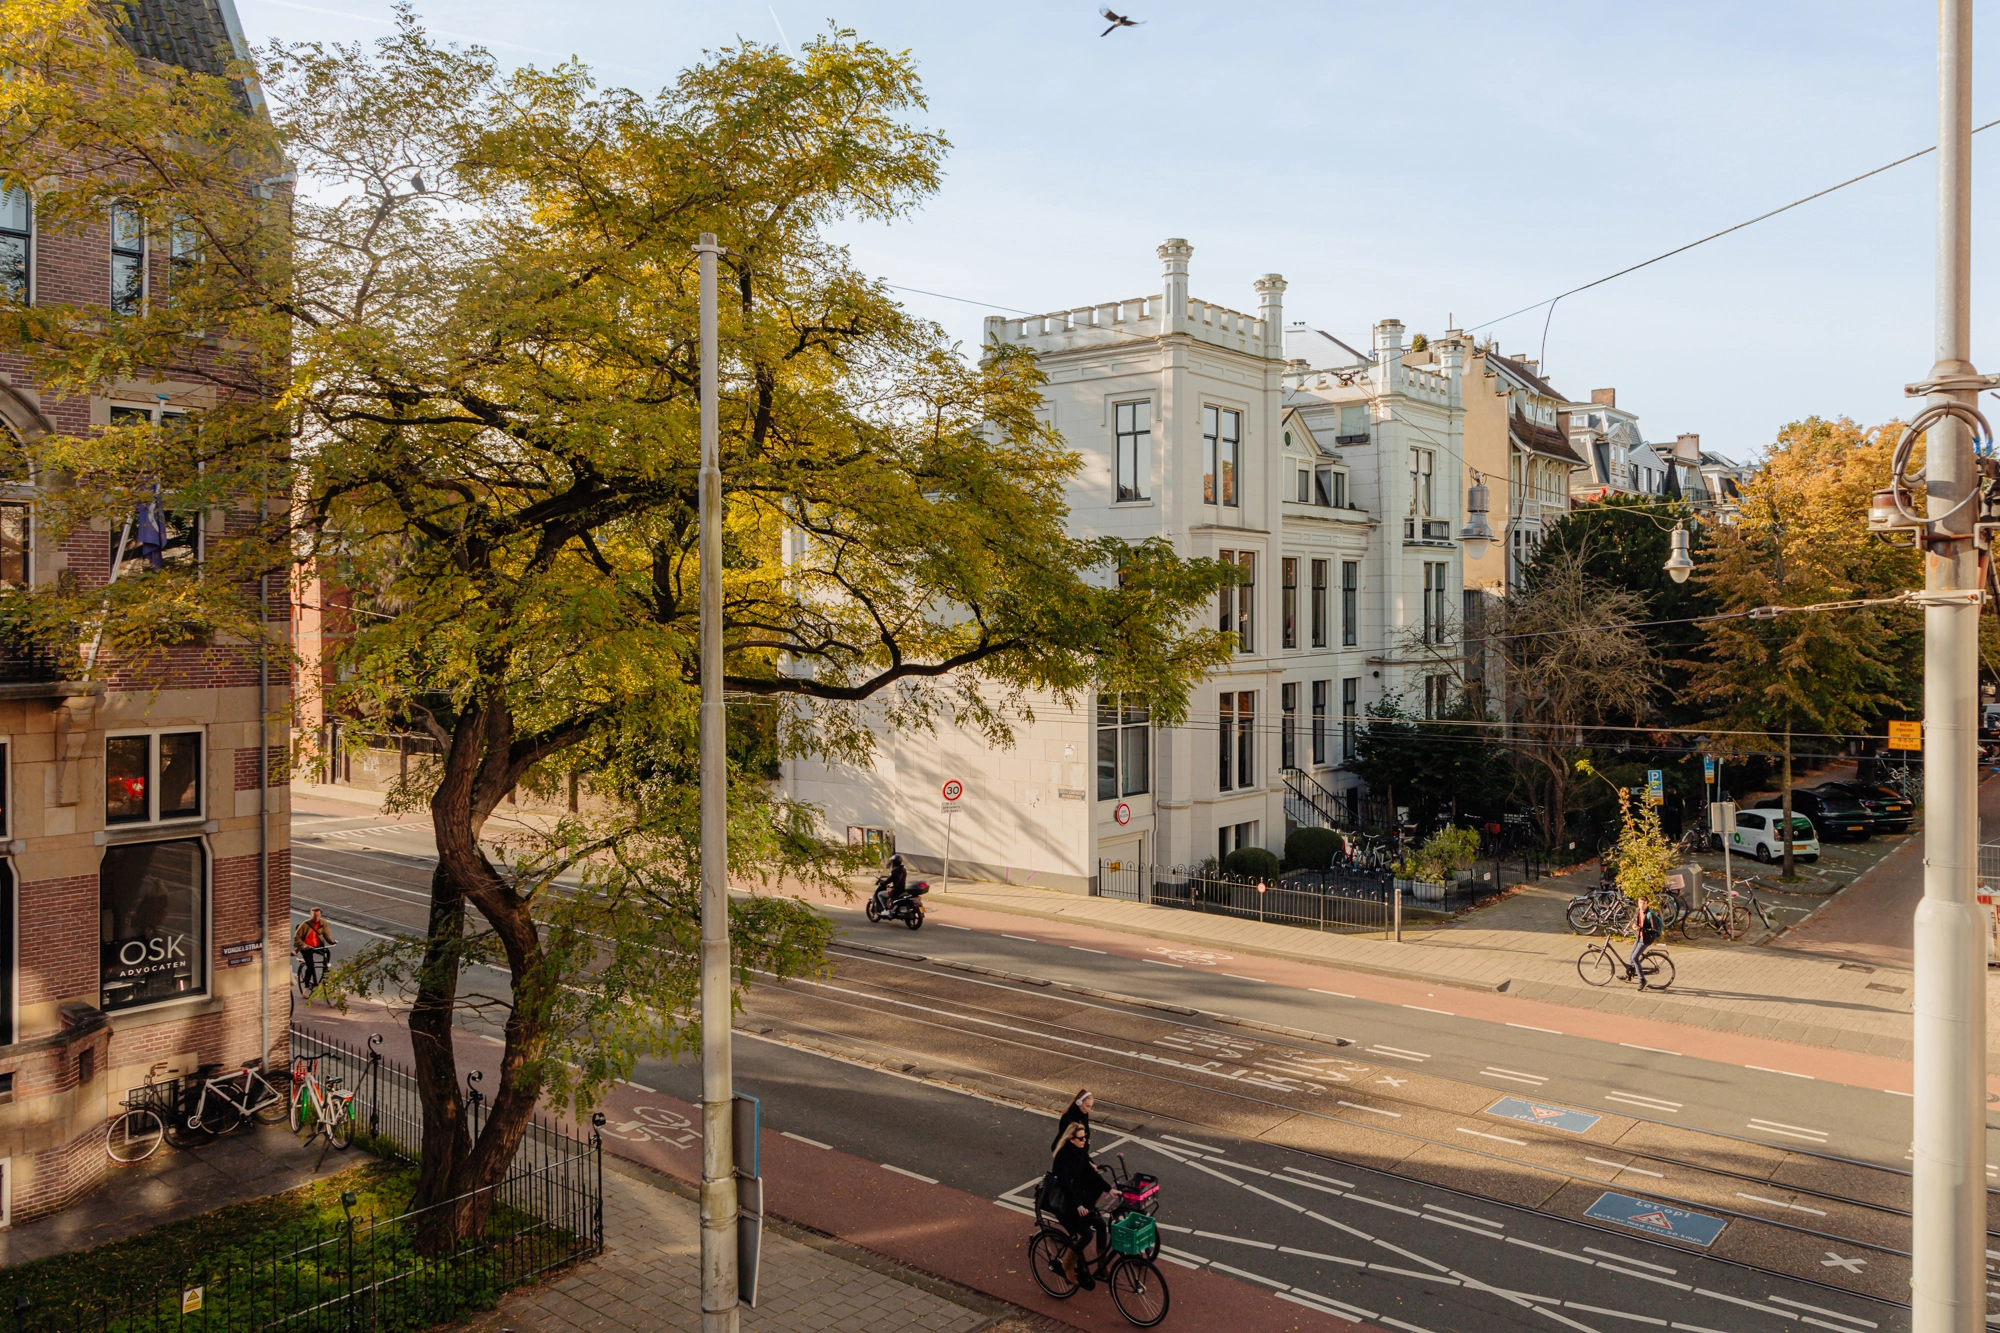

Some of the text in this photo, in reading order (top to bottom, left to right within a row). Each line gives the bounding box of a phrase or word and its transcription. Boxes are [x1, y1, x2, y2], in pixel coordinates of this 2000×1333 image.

[1651, 771, 1659, 782] P
[946, 786, 960, 795] 30
[120, 933, 186, 966] OSK
[223, 942, 263, 955] VONDELSTRAA
[119, 960, 187, 978] ADVOCATEN
[1635, 1200, 1691, 1219] Let op!
[1593, 1212, 1625, 1223] verkeer
[1626, 1220, 1645, 1229] mag
[1647, 1224, 1665, 1233] hier
[1680, 1233, 1703, 1243] km/u
